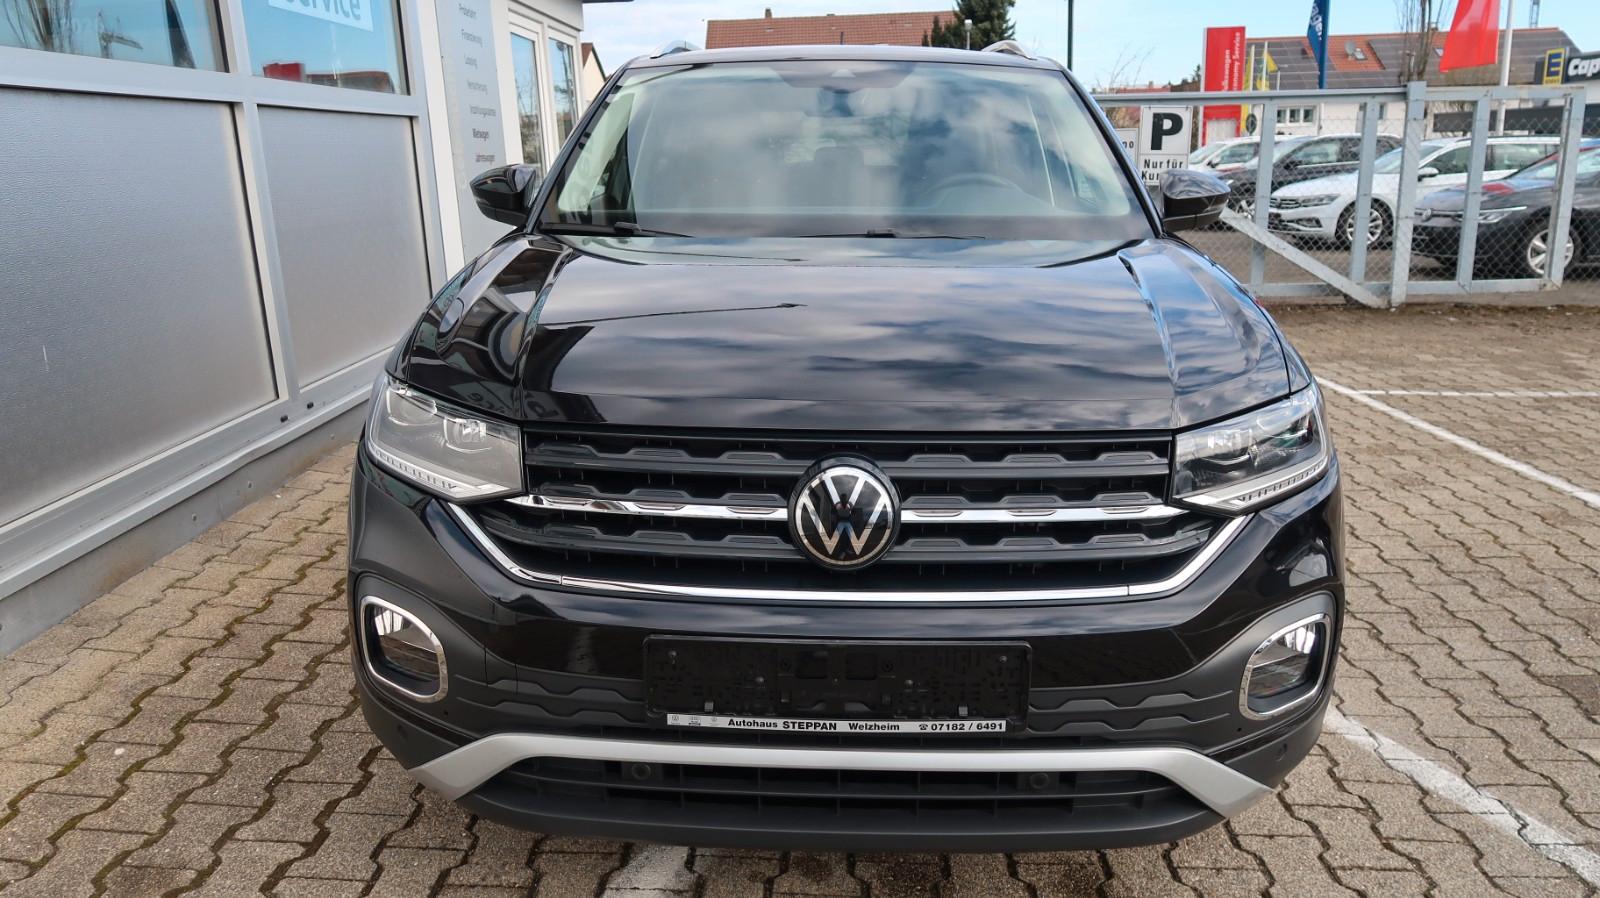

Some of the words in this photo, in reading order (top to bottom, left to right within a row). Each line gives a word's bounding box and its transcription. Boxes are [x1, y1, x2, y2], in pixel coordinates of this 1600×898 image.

[1151, 112, 1184, 151] P
[1144, 159, 1164, 169] Nur
[1166, 159, 1183, 169] für
[728, 719, 778, 729] Autohaus
[782, 720, 837, 731] STEPPAN
[849, 722, 900, 731] Welzheim
[931, 722, 965, 731] 07182
[976, 722, 1003, 731] 6491
